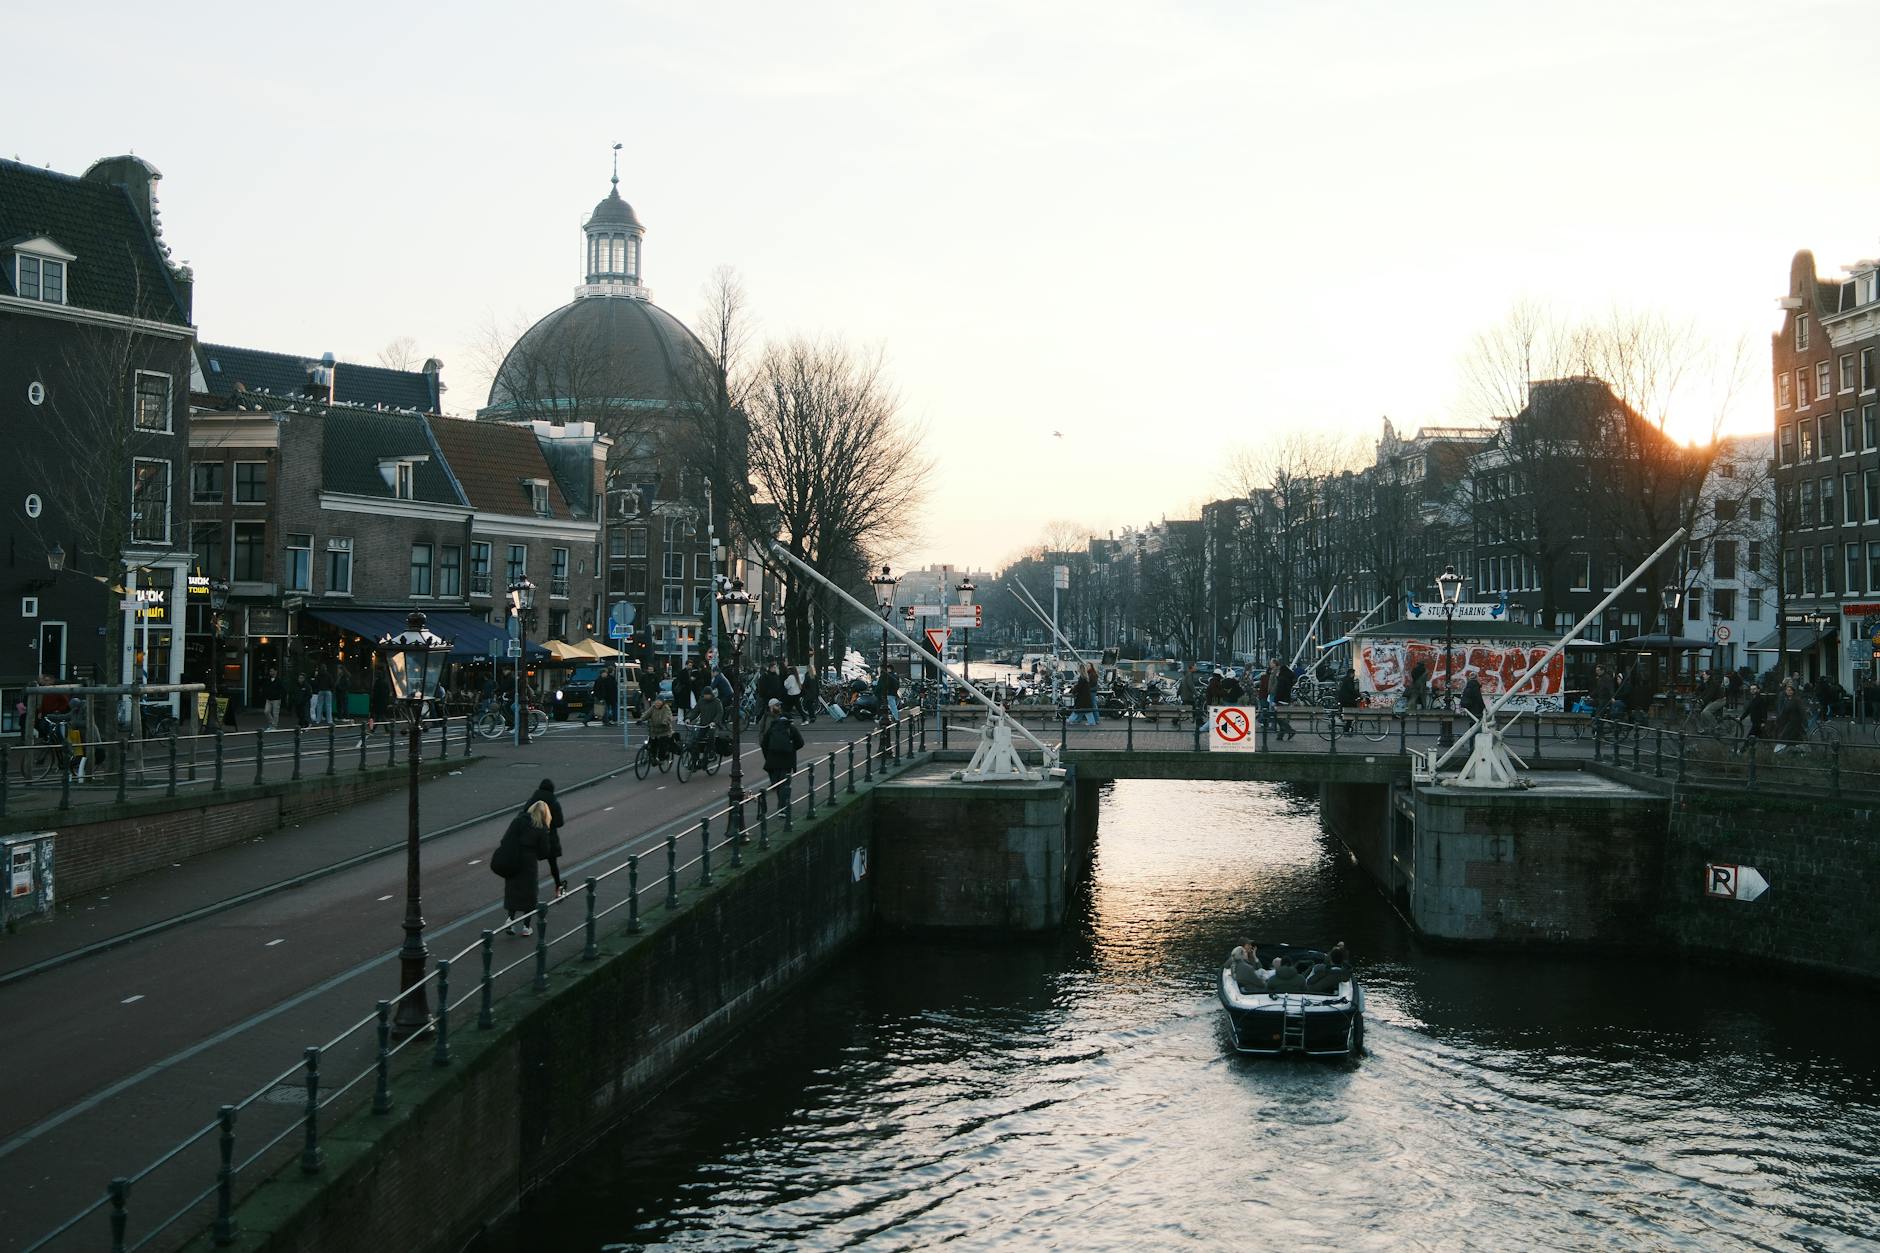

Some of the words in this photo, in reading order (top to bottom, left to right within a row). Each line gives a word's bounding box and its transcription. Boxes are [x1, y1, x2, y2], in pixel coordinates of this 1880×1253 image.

[188, 576, 210, 586] WOK
[136, 590, 164, 602] WOK
[1459, 606, 1486, 617] HARING
[1713, 868, 1734, 894] R
